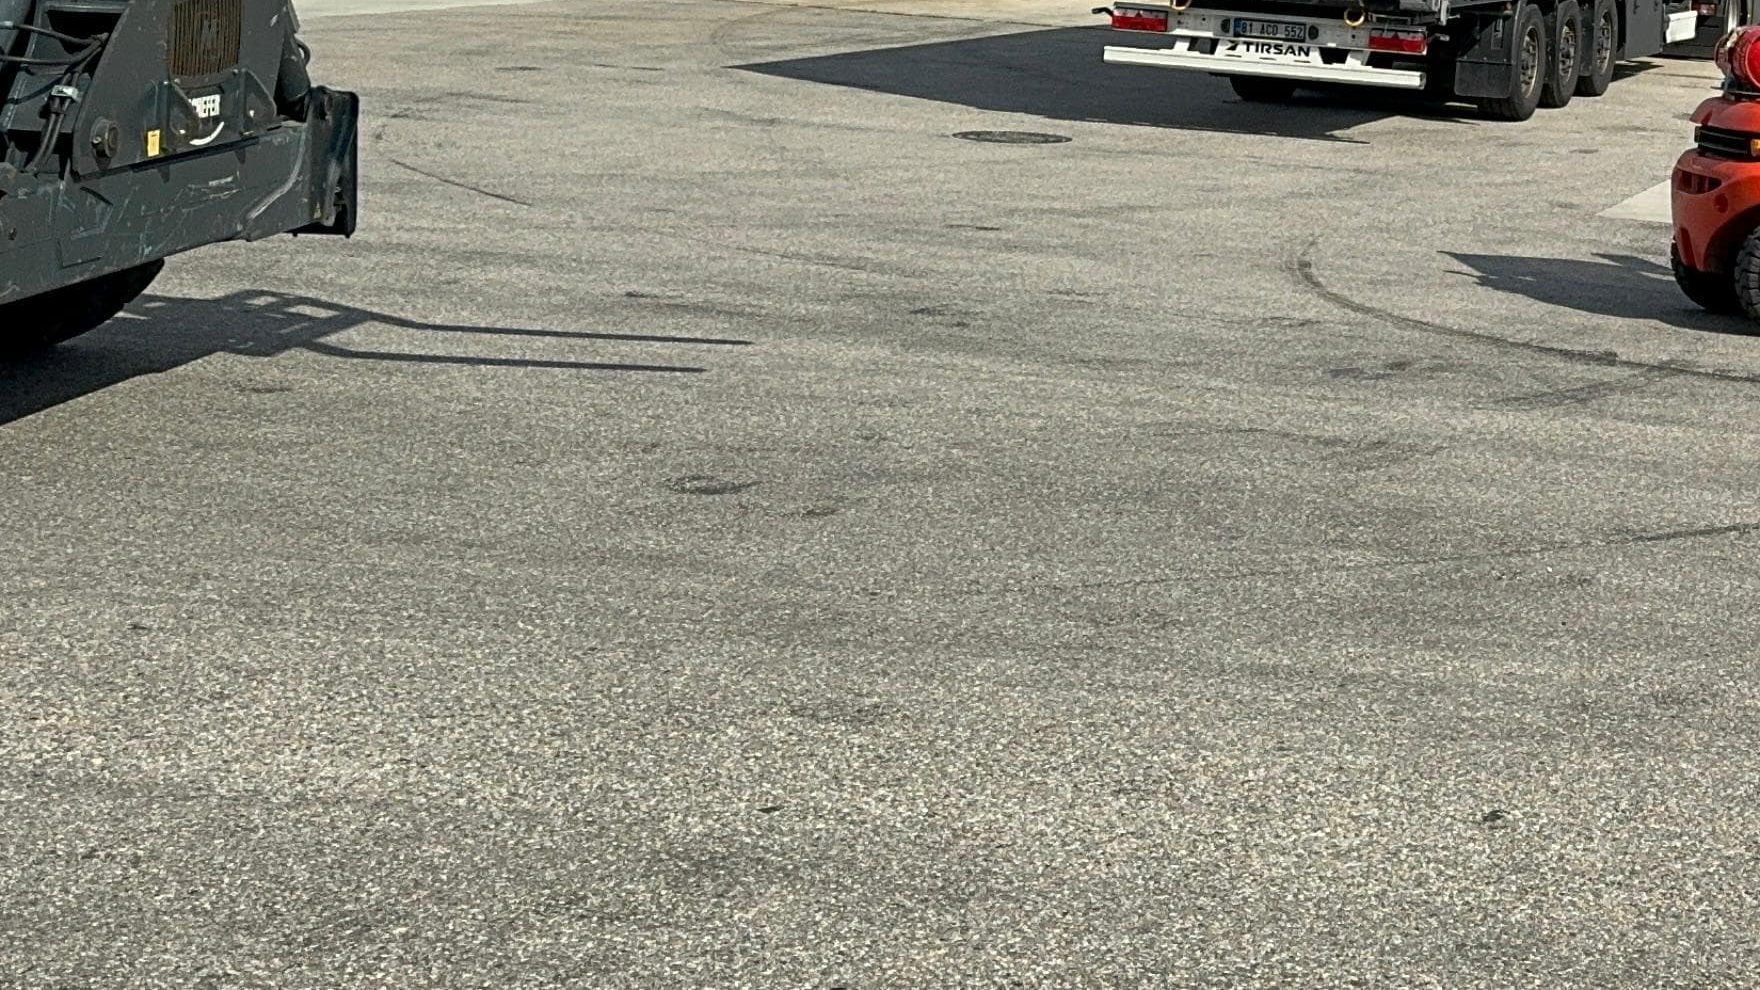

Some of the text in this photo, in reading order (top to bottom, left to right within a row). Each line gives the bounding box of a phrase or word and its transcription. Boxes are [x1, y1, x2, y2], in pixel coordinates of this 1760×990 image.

[1241, 22, 1253, 34] 81
[1284, 26, 1303, 39] 552
[1242, 41, 1310, 57] TIRSAN
